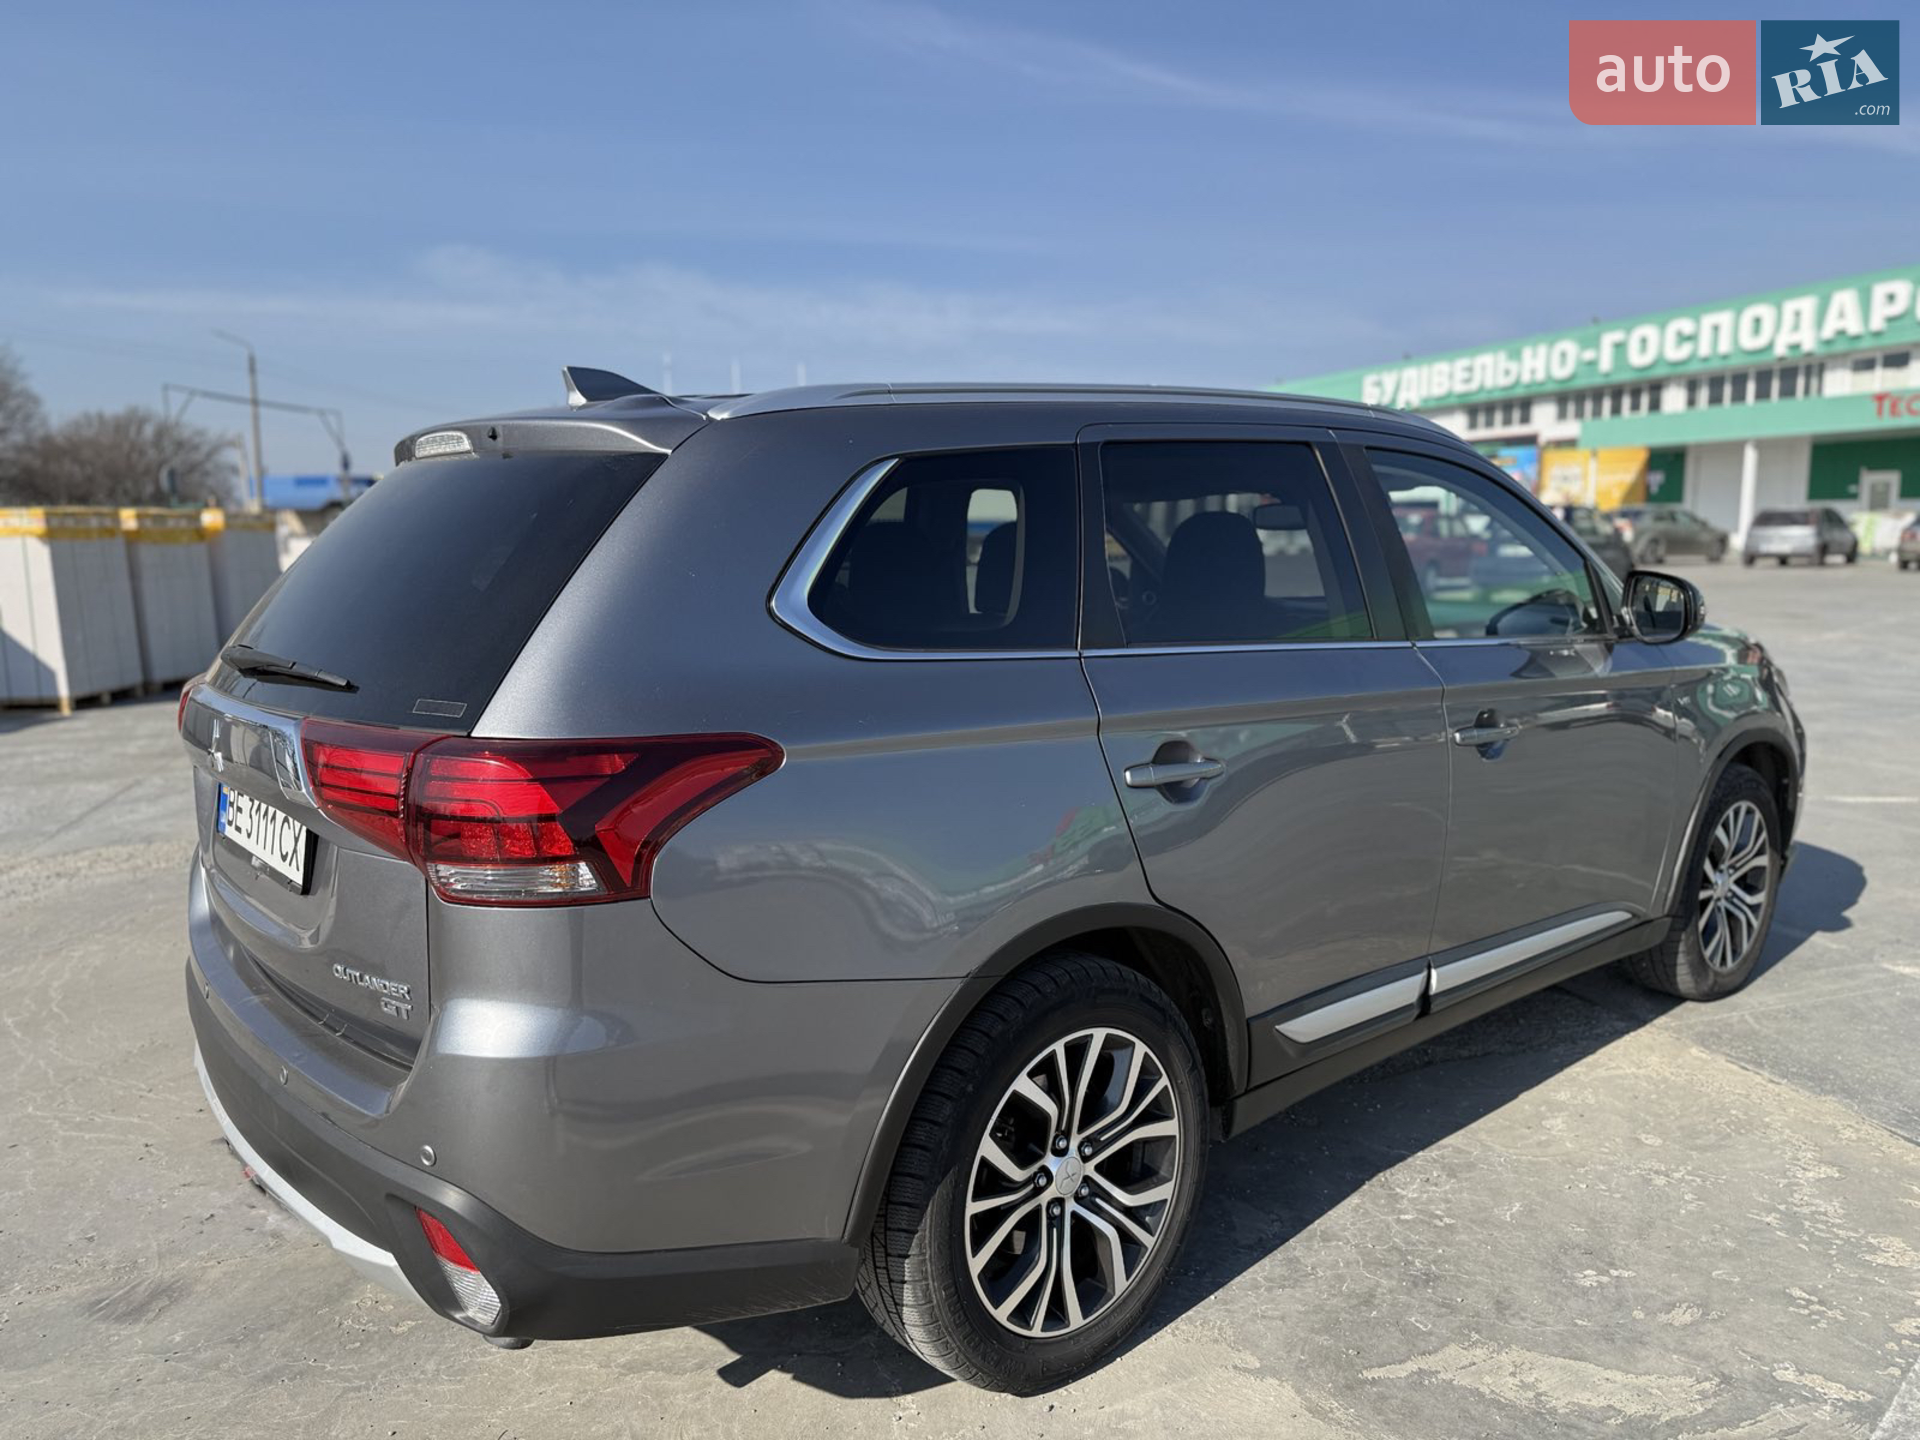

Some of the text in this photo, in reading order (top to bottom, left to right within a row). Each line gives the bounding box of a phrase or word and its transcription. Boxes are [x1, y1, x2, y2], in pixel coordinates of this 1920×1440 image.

[1361, 278, 1920, 409] БУДІВЕЛЬНО-ГОСПОДАР
[332, 963, 412, 1001] OUTLANDER
[381, 996, 413, 1021] GT
